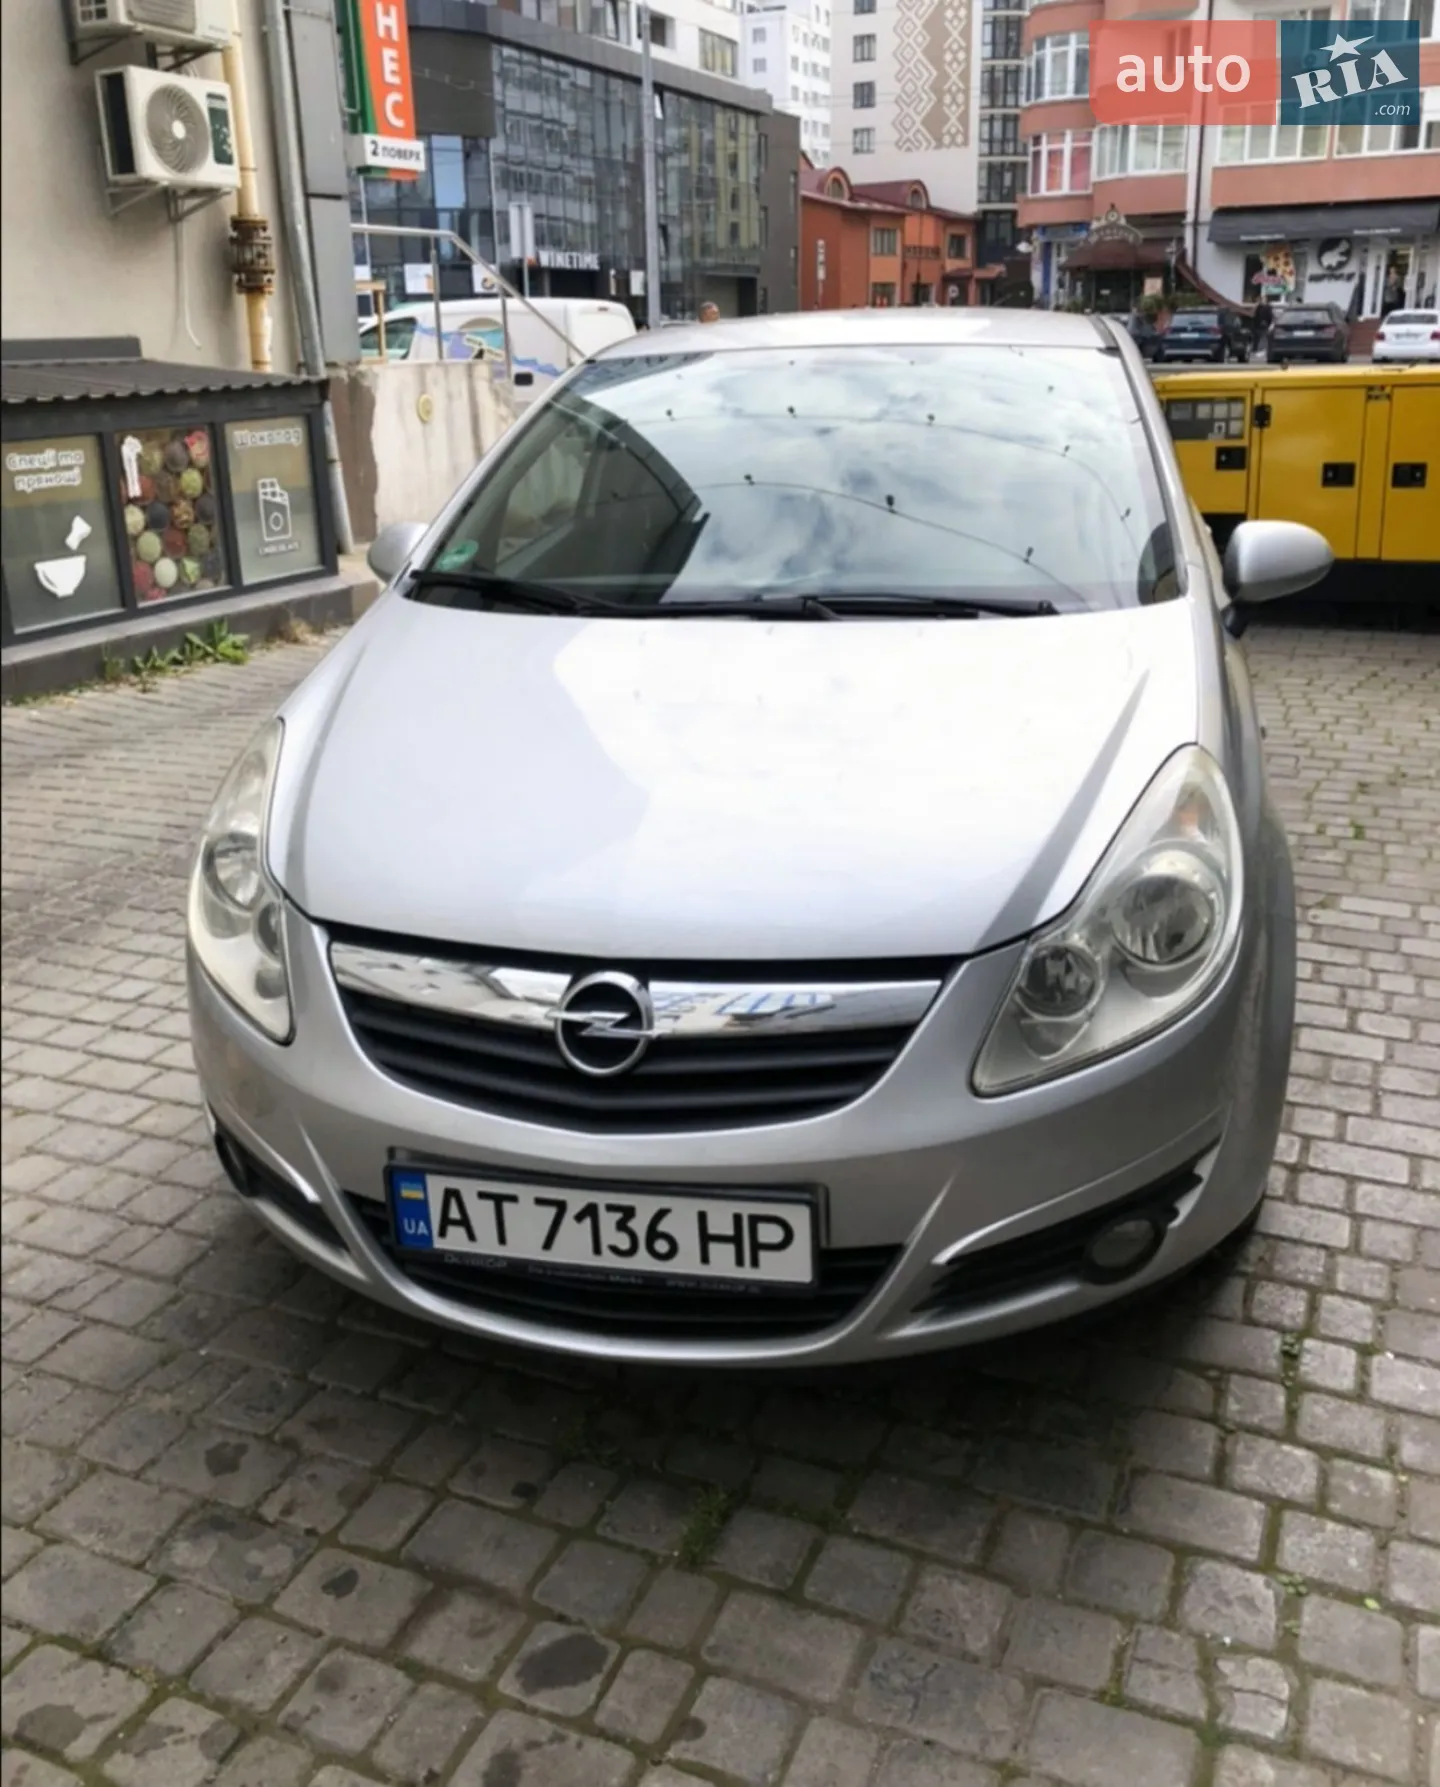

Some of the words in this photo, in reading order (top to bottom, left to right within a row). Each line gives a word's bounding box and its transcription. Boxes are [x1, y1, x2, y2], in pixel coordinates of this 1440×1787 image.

[370, 139, 380, 157] 2
[382, 145, 422, 161] ПОВЕРХ
[539, 250, 600, 271] WINETIME
[233, 428, 302, 448] Шоколад
[403, 1217, 429, 1236] UA
[438, 1186, 519, 1247] AT
[533, 1196, 680, 1262] 7136
[697, 1210, 795, 1269] HP
